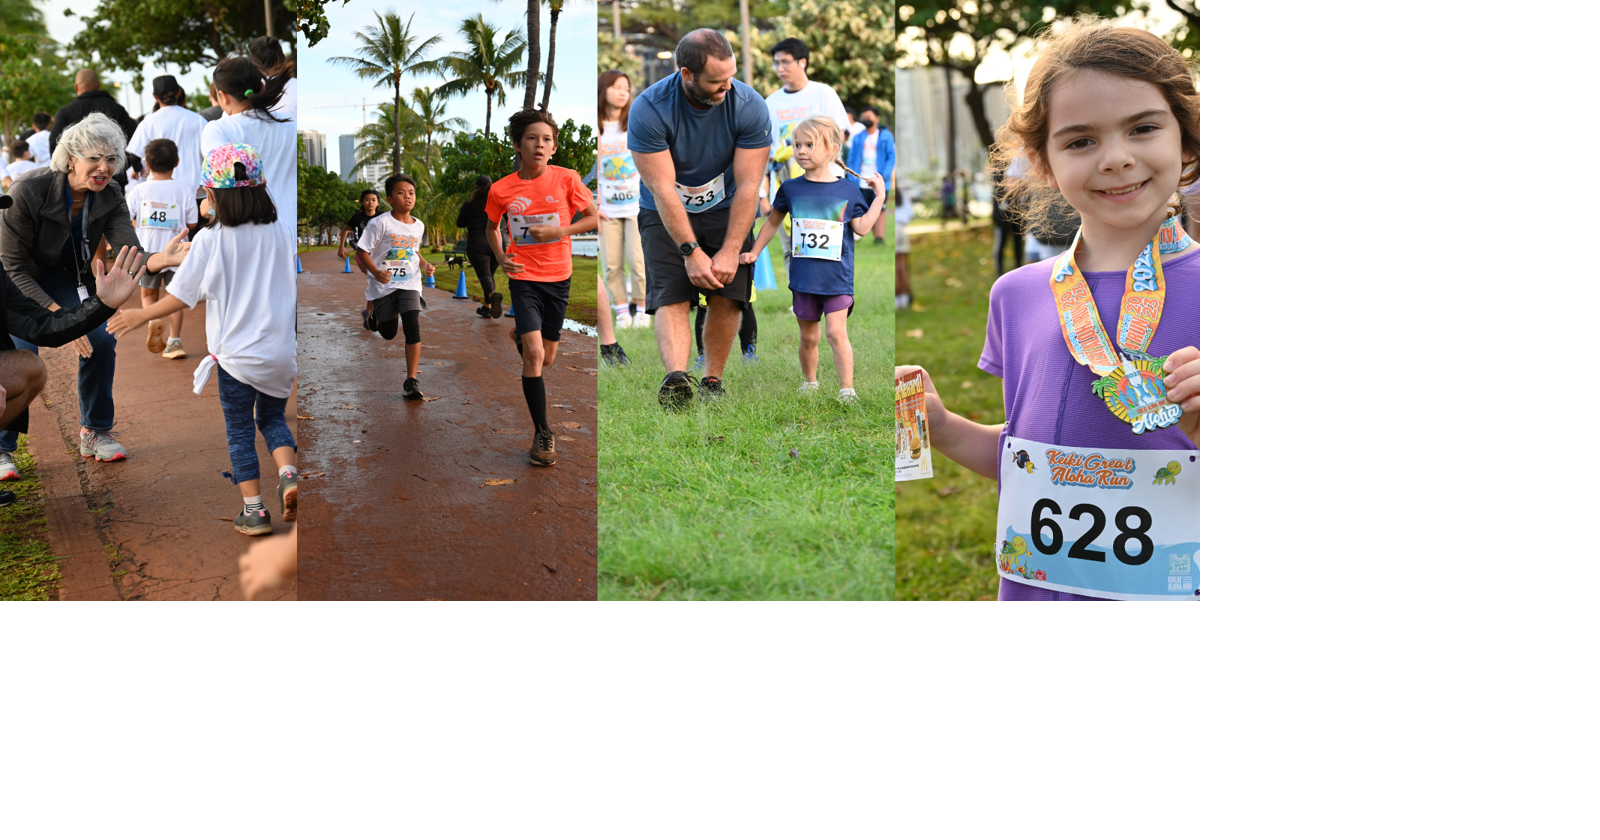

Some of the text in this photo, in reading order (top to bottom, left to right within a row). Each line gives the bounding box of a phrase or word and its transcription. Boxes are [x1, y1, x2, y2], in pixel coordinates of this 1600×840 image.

[612, 191, 633, 201] 406
[683, 191, 714, 206] 733
[150, 211, 166, 222] 48
[1060, 290, 1077, 310] 20
[1072, 281, 1089, 302] 23
[1125, 296, 1143, 315] 20
[1142, 298, 1160, 320] 23
[1119, 313, 1131, 344] HEALTH
[1126, 315, 1150, 344] RUN
[1132, 404, 1181, 434] Aloha
[1046, 450, 1132, 471] Keiki Great
[1051, 466, 1130, 486] Aloha Run
[1031, 498, 1154, 566] 628
